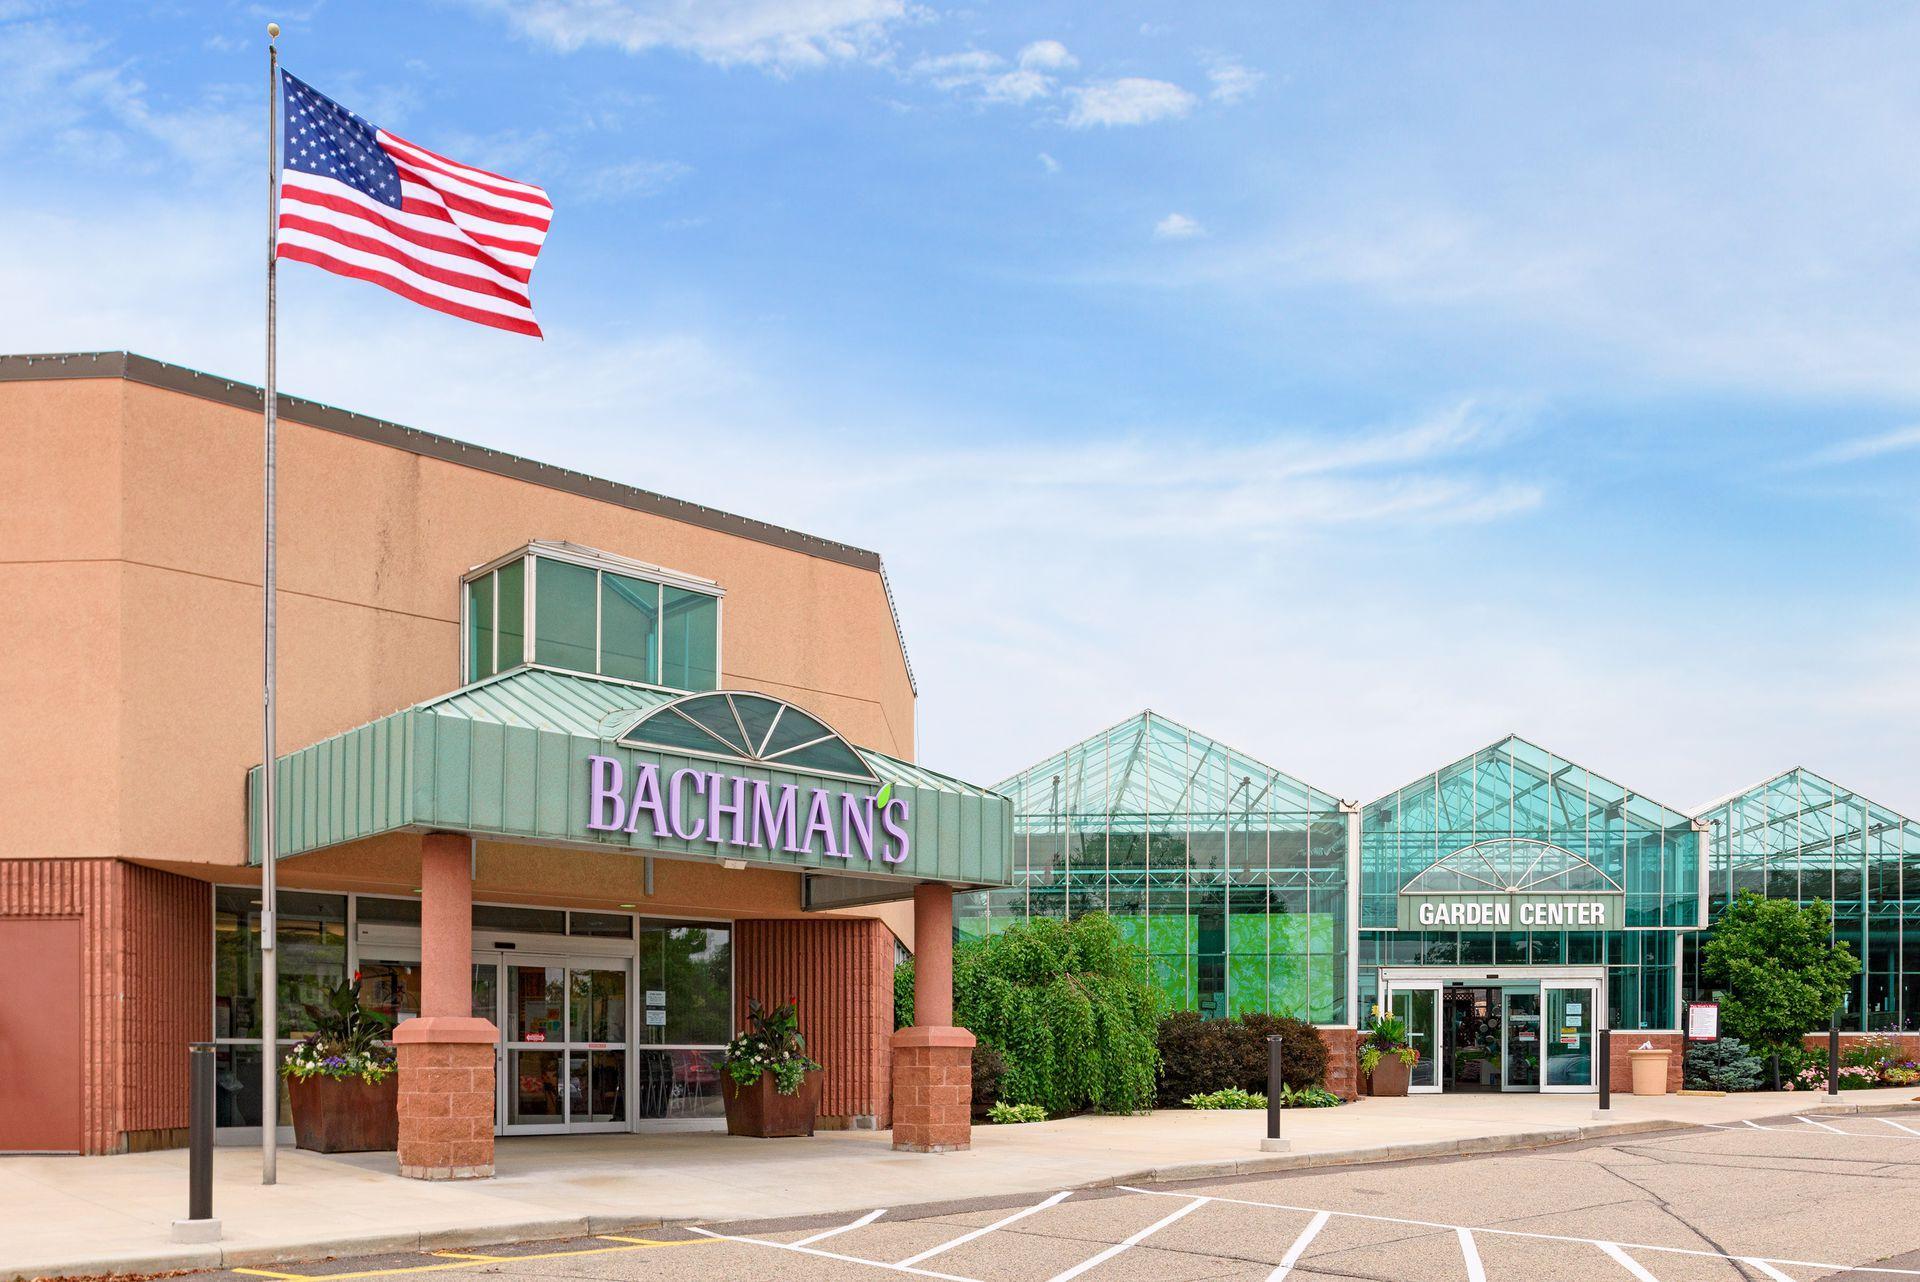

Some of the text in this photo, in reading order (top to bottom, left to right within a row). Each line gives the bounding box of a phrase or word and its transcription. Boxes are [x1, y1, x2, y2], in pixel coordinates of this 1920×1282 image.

[587, 755, 909, 864] BACHMAN'S
[1419, 902, 1605, 925] GARDEN CENTER
